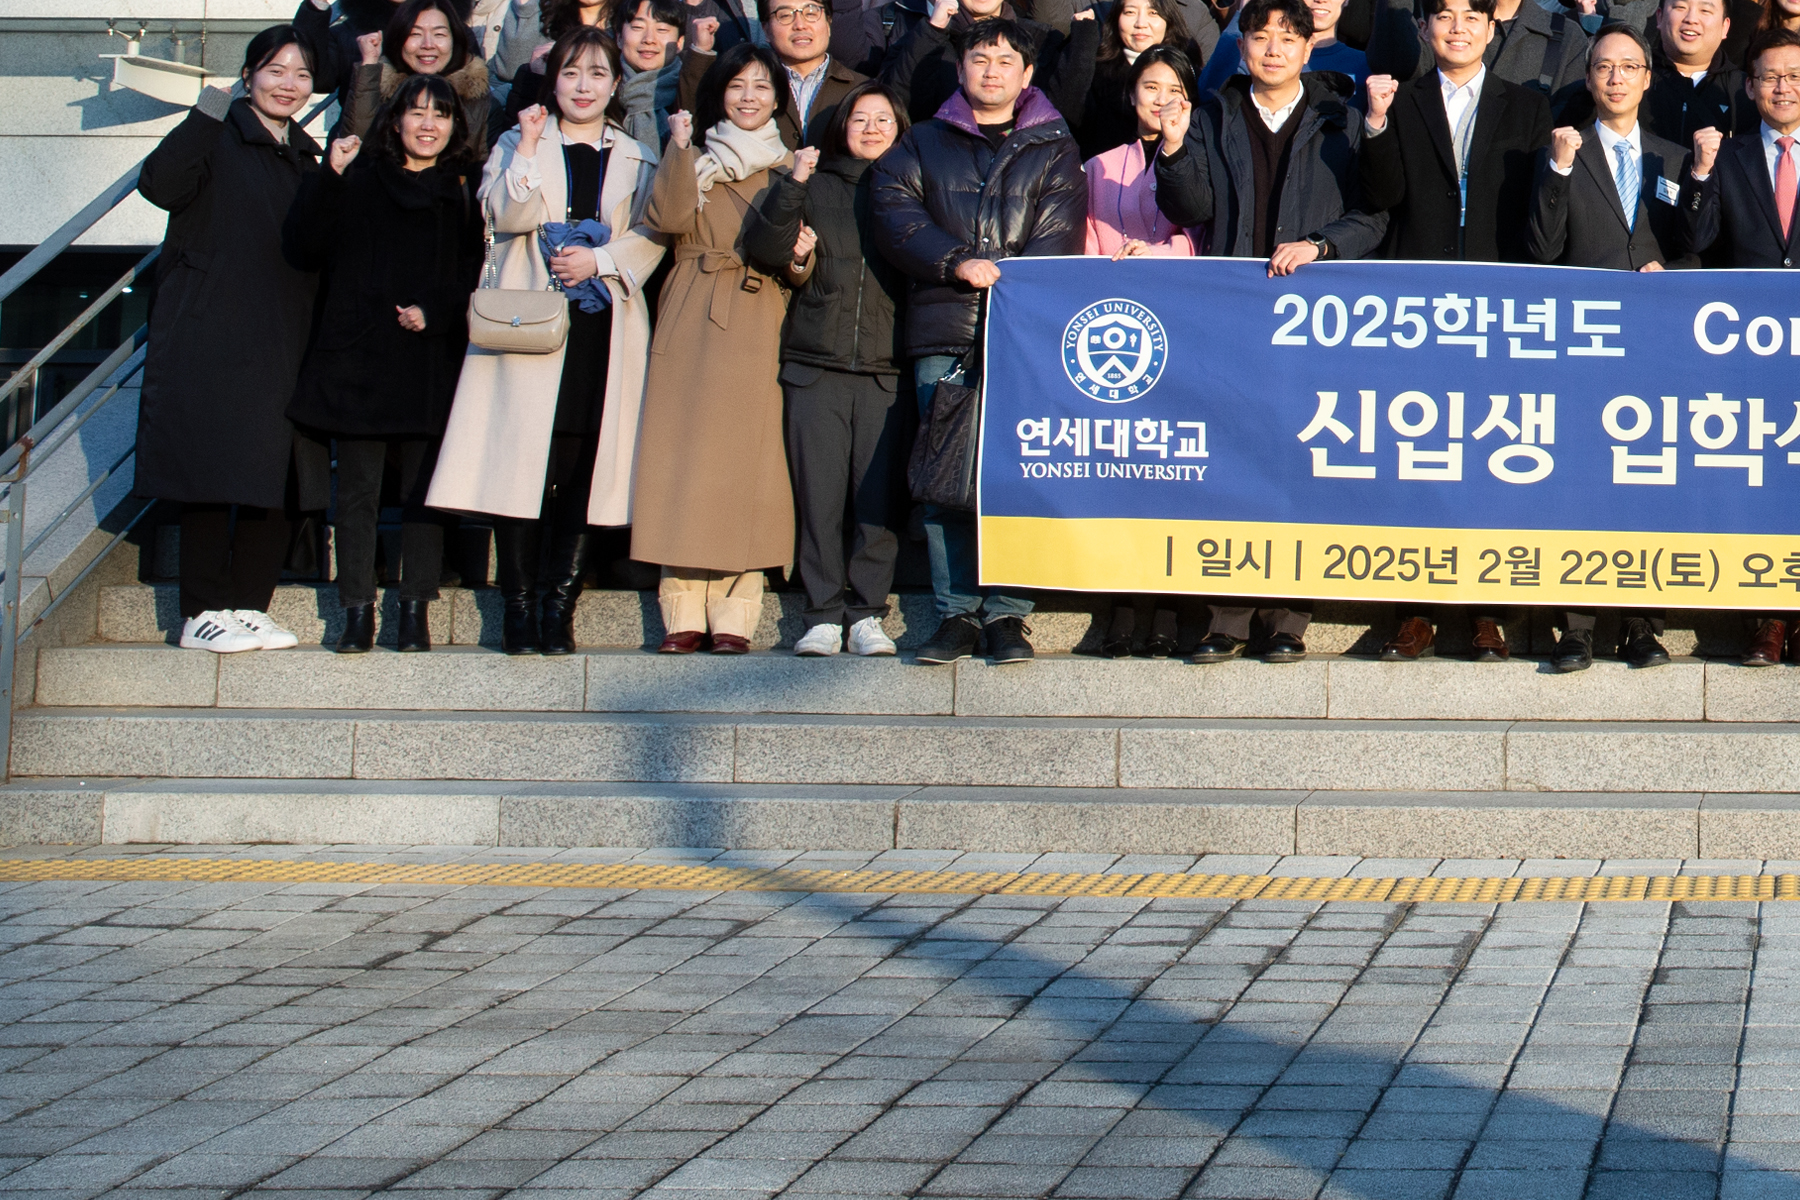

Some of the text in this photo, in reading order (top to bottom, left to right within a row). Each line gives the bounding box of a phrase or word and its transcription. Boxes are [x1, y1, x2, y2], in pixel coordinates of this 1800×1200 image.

[1066, 303, 1164, 352] YONSEI UNIVERSITY
[1270, 292, 1627, 360] 2025학년도
[1015, 416, 1210, 459] 연세대학교
[1296, 389, 1557, 485] 신입생
[1019, 461, 1208, 481] YONSEI UNIVERSITY
[1197, 538, 1272, 579] 일시
[1323, 544, 1458, 585] 2025년
[1478, 546, 1541, 587] 2월
[1559, 548, 1720, 593] 22일(토)
